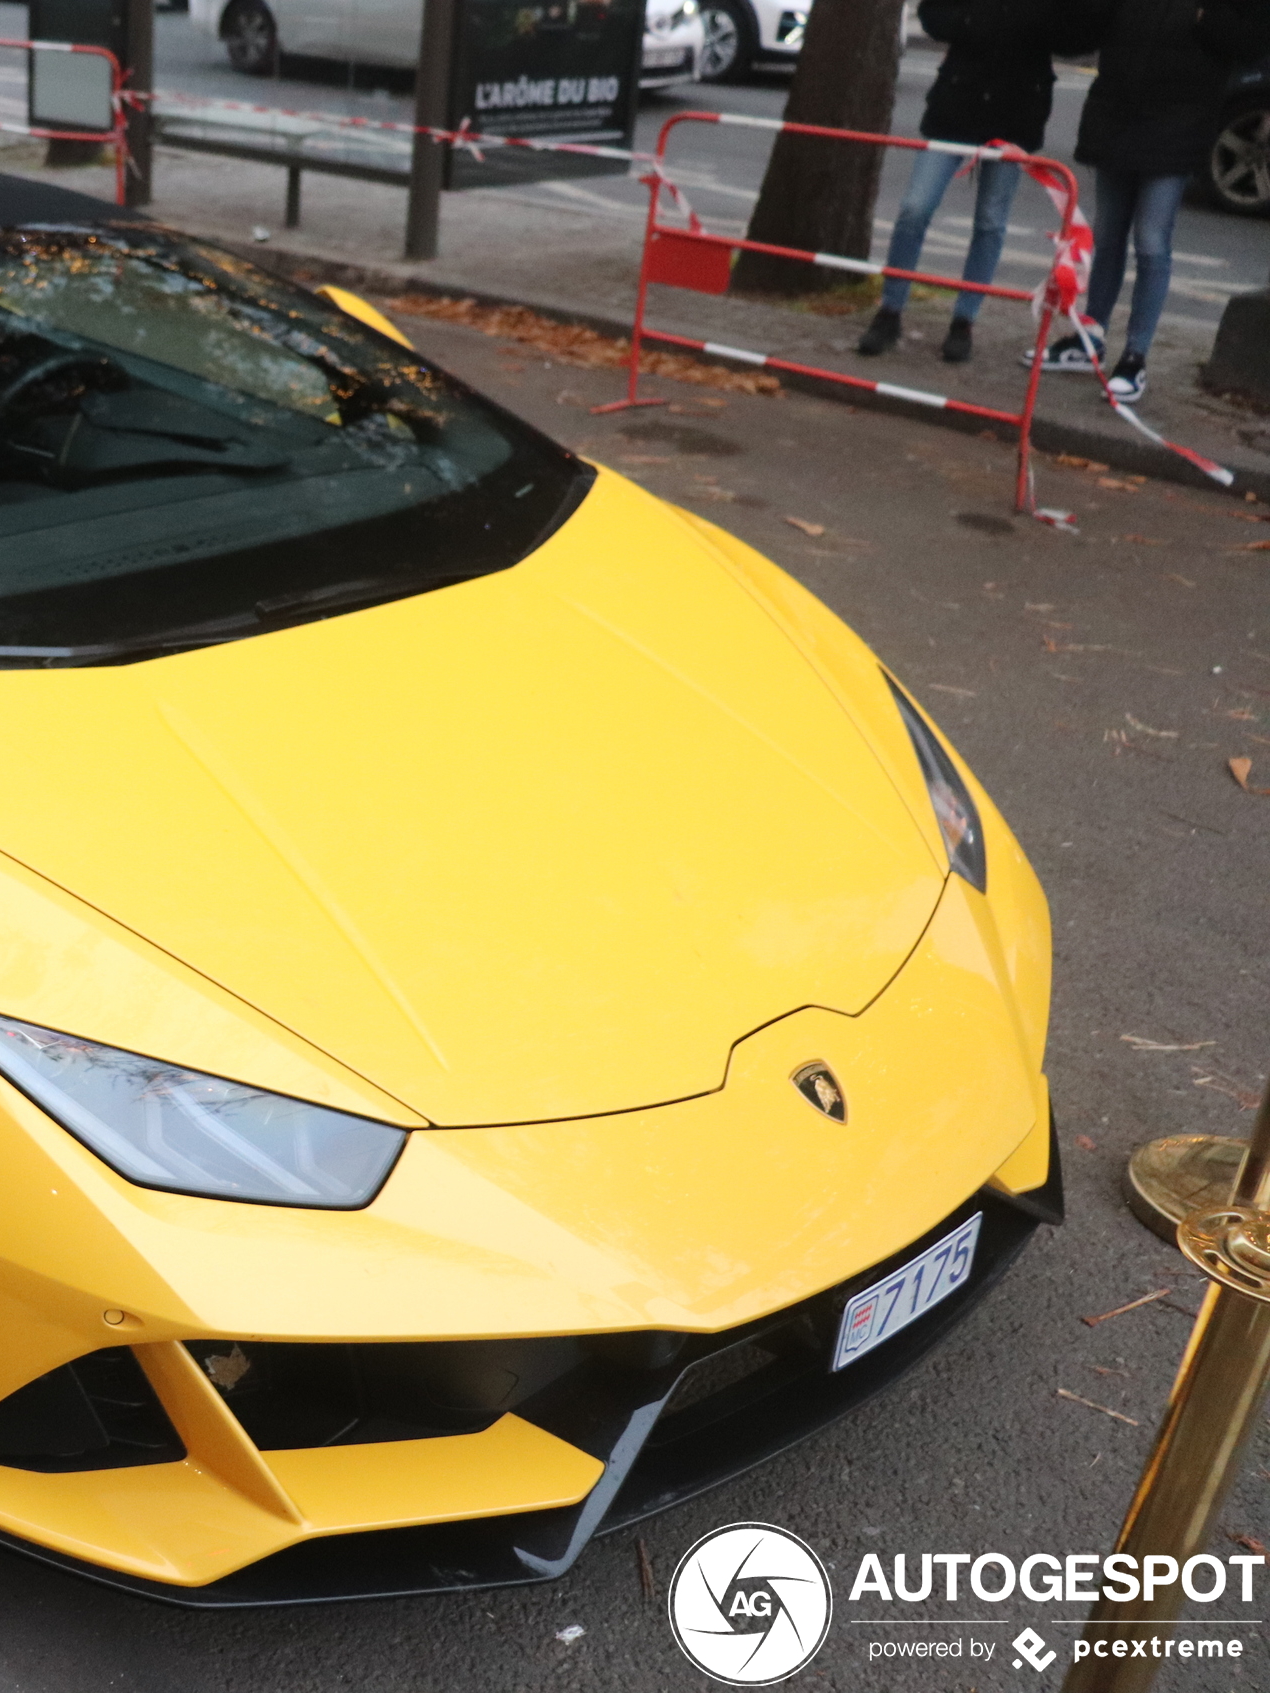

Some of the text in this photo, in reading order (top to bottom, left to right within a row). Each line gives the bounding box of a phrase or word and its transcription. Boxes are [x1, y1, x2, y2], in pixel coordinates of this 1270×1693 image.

[475, 74, 619, 109] L'ARÔME DU BIO
[877, 1229, 972, 1337] 7175
[850, 1325, 868, 1343] MC
